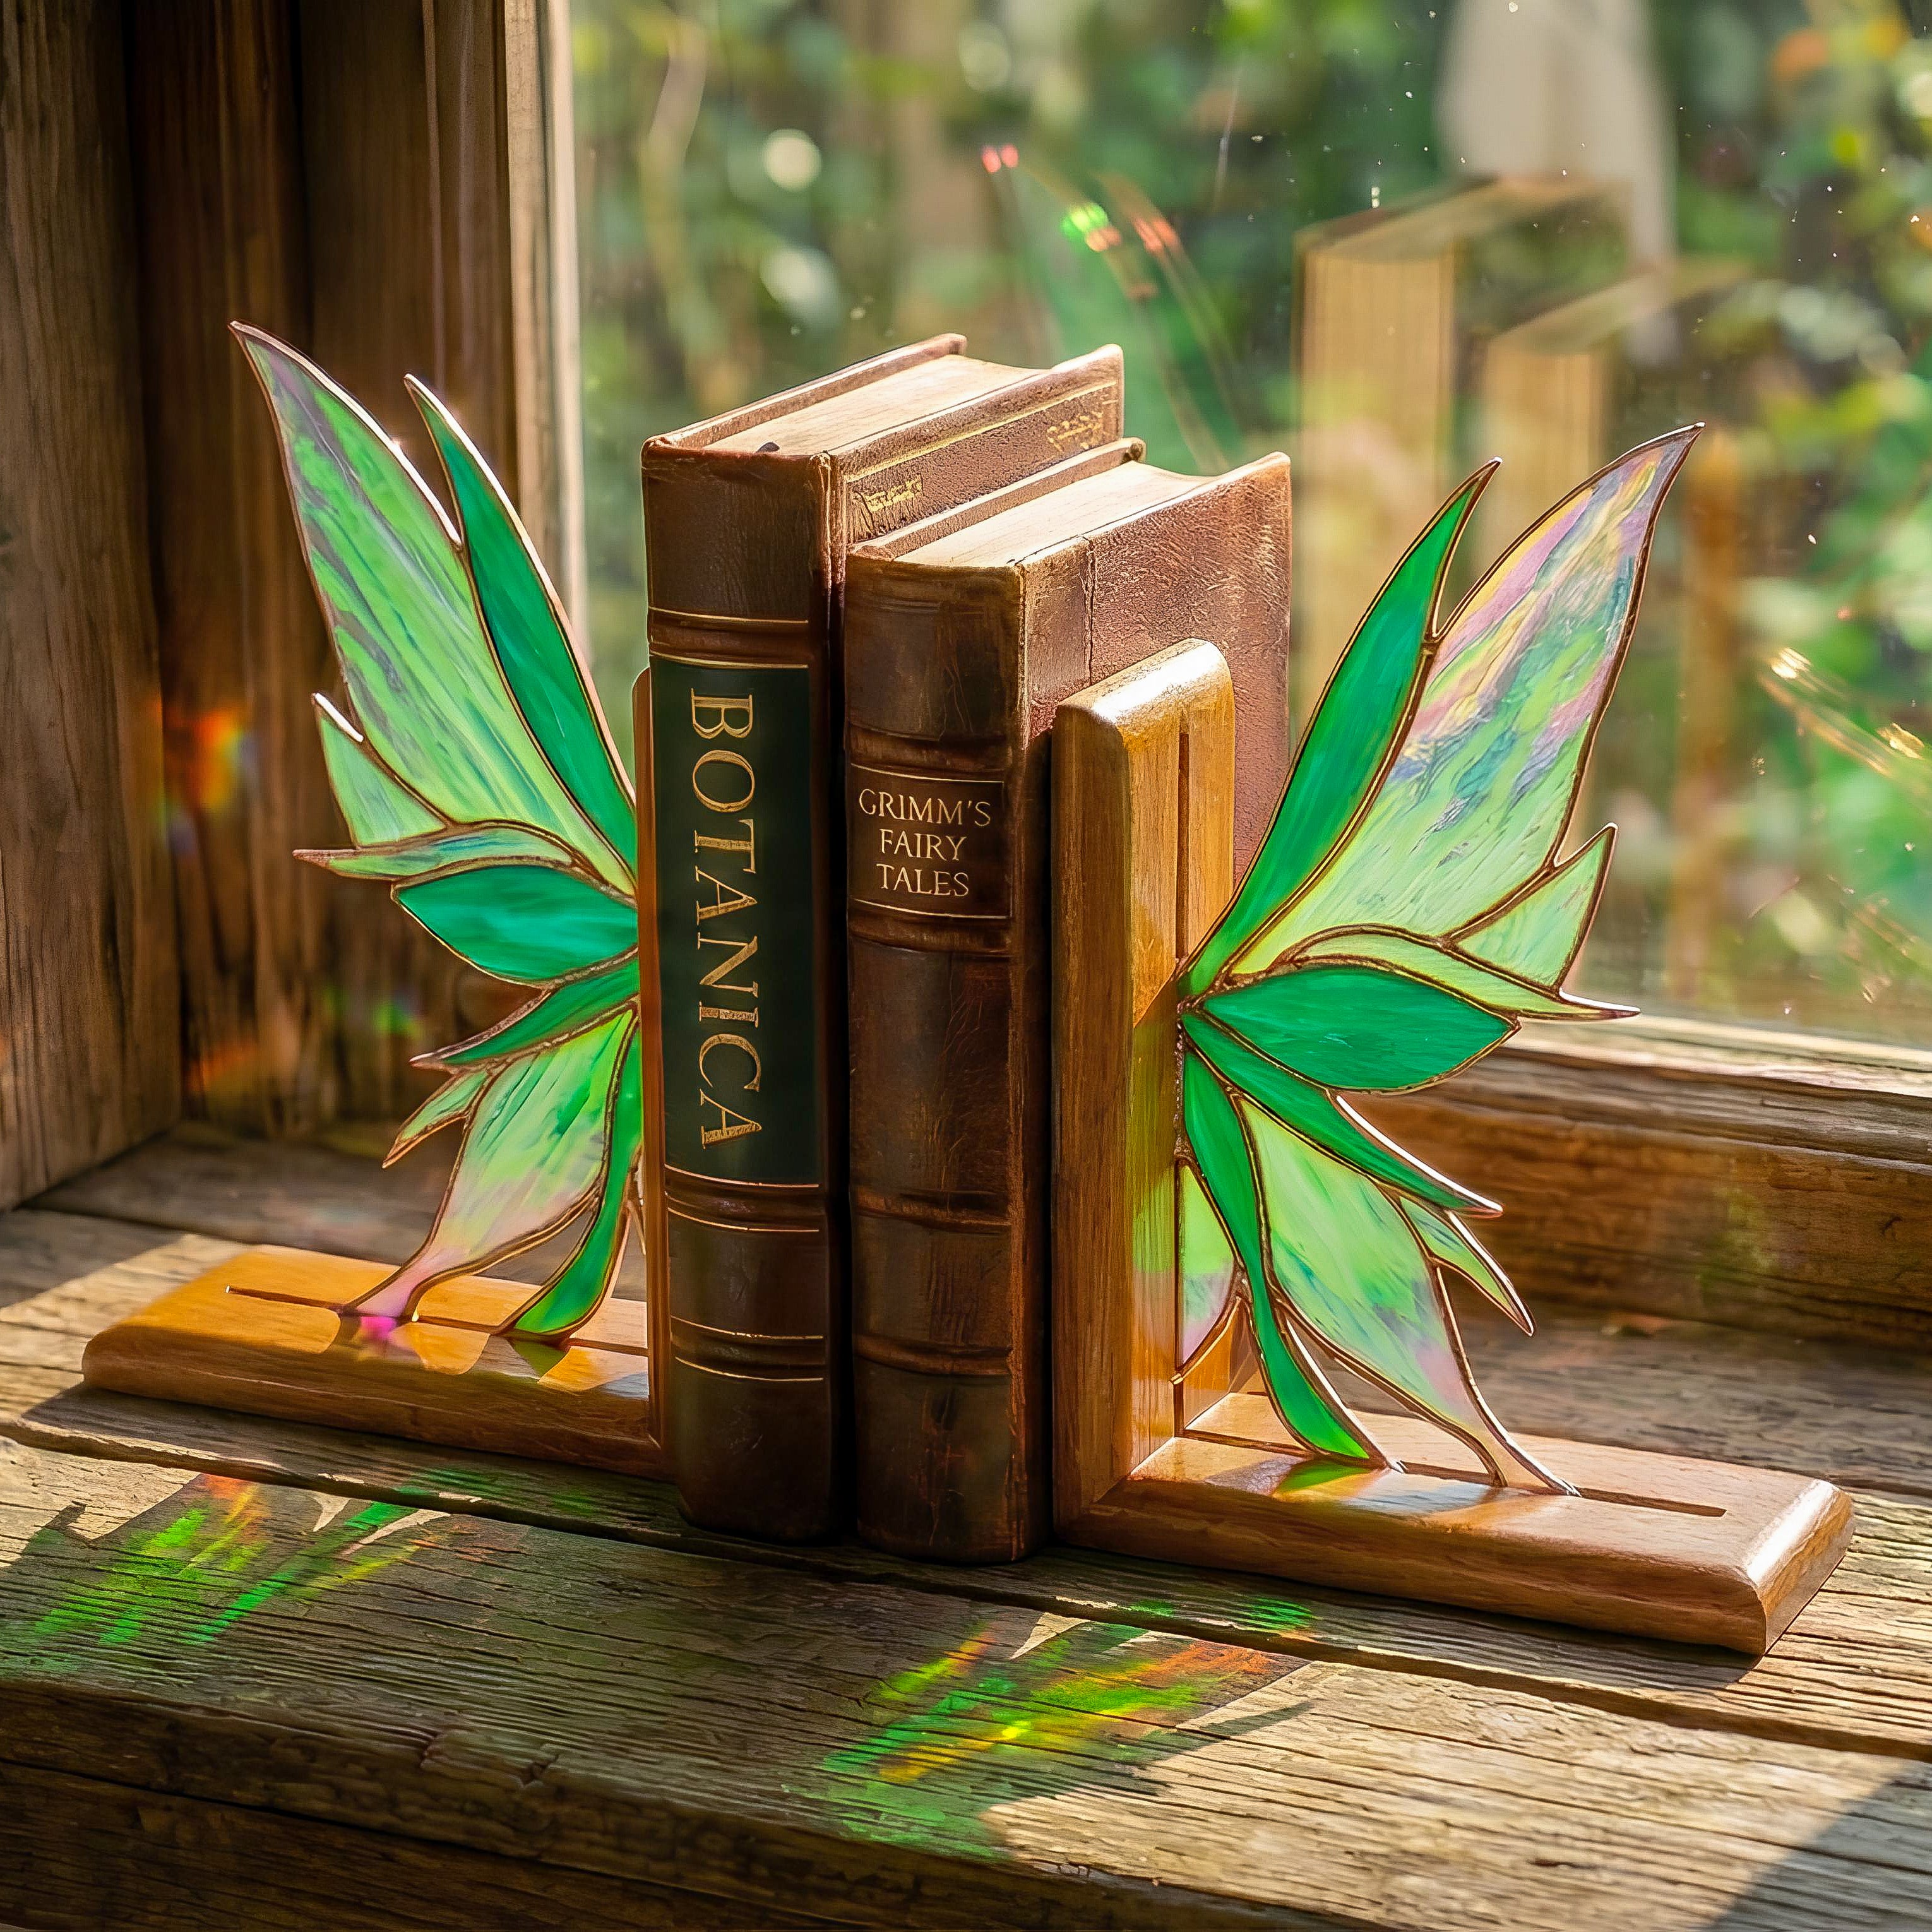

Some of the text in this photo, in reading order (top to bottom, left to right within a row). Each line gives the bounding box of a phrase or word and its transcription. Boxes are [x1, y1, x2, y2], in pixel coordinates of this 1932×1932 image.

[859, 789, 991, 826] GRIMM'S
[880, 828, 967, 861] FAIRY
[876, 863, 969, 897] TALES
[691, 688, 762, 1149] BOTANICA
